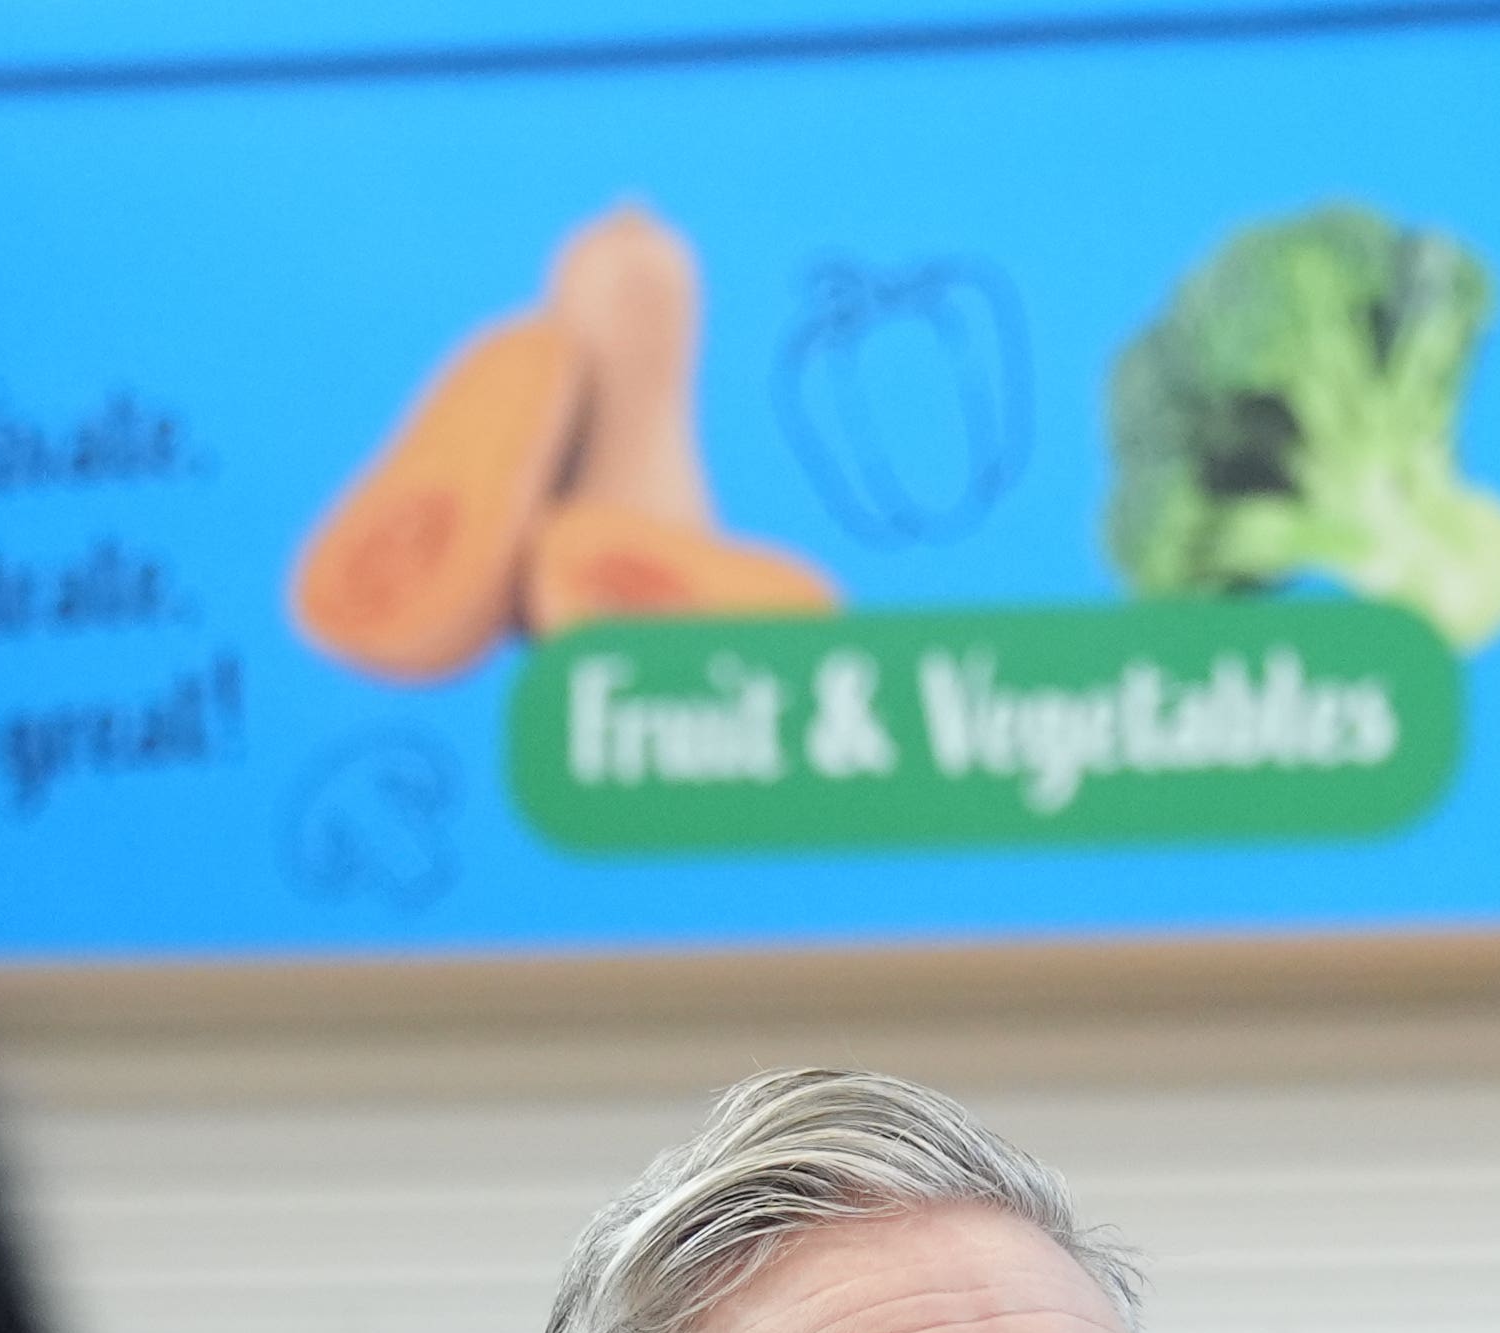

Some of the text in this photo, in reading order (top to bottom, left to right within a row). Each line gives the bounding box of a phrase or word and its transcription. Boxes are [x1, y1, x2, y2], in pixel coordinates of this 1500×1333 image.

[566, 646, 1396, 814] Fruit & Vegetables
